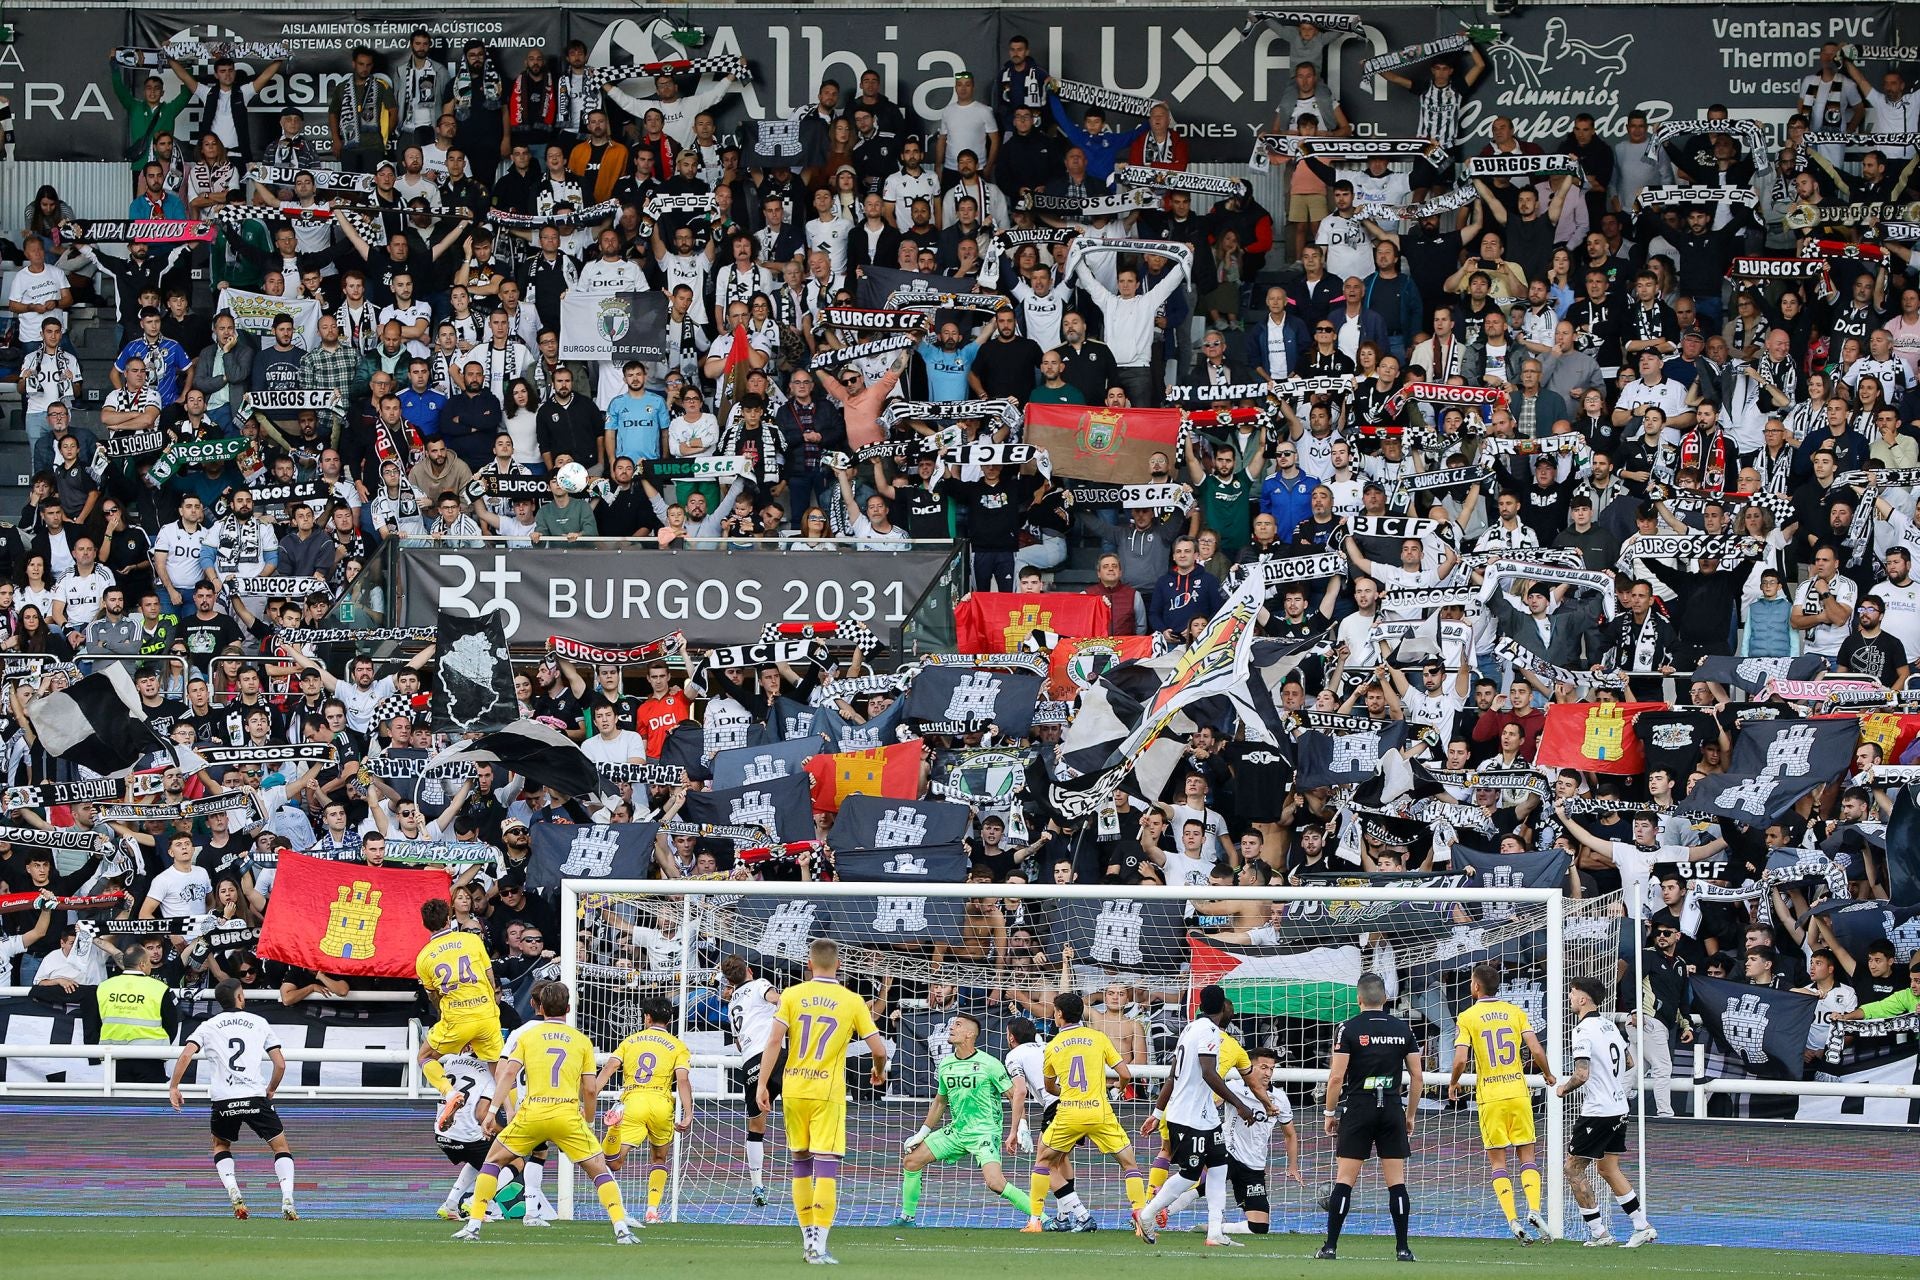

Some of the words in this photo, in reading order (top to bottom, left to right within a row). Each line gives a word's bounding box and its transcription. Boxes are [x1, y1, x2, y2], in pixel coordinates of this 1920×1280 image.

[281, 23, 371, 35] AISLAMIENTOS
[1712, 18, 1822, 39] Ventanas
[1829, 17, 1875, 38] PVC
[282, 37, 341, 50] SISTEMAS
[344, 37, 373, 50] CON
[483, 37, 546, 49] LAMINADO
[1861, 44, 1919, 59] BURGOS
[682, 25, 978, 121] Albia
[1729, 79, 1757, 94] Uw
[1059, 83, 1095, 102] BURGOS
[1096, 90, 1119, 107] CLUB
[1664, 119, 1731, 133] BURGOS
[1311, 142, 1391, 153] BURGOS
[1395, 142, 1425, 154] CF
[1474, 157, 1541, 174] BURGOS
[1544, 157, 1572, 172] C.F.
[1035, 193, 1099, 210] BURGOS
[1105, 194, 1132, 208] C.F.
[1641, 190, 1726, 202] BURGOS
[1729, 191, 1756, 204] CF
[1817, 206, 1878, 222] BURGOS
[86, 222, 124, 239] AUPA
[127, 220, 185, 238] BURGOS
[673, 268, 698, 278] DIGI
[1738, 259, 1802, 276] BURGOS
[591, 280, 624, 288] DIGI
[1028, 303, 1056, 312] DIGI
[243, 318, 273, 328] CLU
[830, 309, 893, 329] BURGOS
[898, 311, 918, 329] CF
[1834, 318, 1866, 336] DIGI
[563, 345, 597, 353] BURGOS
[596, 345, 618, 354] CLUB
[618, 346, 630, 354] DE
[631, 346, 662, 355] FUTBOL
[836, 334, 913, 364] CAMPEADOR
[934, 363, 966, 372] DIGI
[252, 389, 304, 409] BURGOS
[1170, 386, 1192, 402] OY
[623, 419, 654, 428] DIGI
[120, 430, 163, 455] BURGOS
[654, 463, 710, 476] BURGOS
[714, 460, 735, 472] C.F.
[498, 480, 551, 494] BURGO
[1414, 473, 1450, 489] BURGOS
[294, 483, 317, 498] C.F.
[1073, 487, 1138, 504] BURGOS
[1142, 484, 1169, 500] C.F.
[911, 504, 942, 515] DIGI
[1633, 535, 1703, 555] BURGOS
[1263, 557, 1316, 580] URGOS
[243, 577, 296, 593] BURGOS
[69, 595, 97, 606] DIGI
[549, 577, 762, 620] BURGOS
[783, 580, 907, 621] 2031
[1891, 601, 1916, 609] REALE
[555, 638, 651, 663] BURGOSCF
[650, 713, 677, 731] DIGI
[719, 715, 750, 726] DIGI
[1308, 713, 1384, 731] BURGOS
[1417, 710, 1444, 720] DIGI
[213, 749, 291, 763] BURGOS
[300, 747, 325, 759] CF
[974, 755, 1004, 764] CLUB
[71, 778, 119, 801] BURGOS
[1678, 862, 1728, 878] BCF
[211, 926, 261, 946] BURGO
[434, 955, 483, 994] 24
[109, 993, 145, 1004] SICOR
[448, 995, 489, 1010] MERITKING
[812, 997, 839, 1010] BIUK
[217, 1018, 254, 1030] LIZANCOS
[730, 1003, 743, 1034] 6
[1480, 1013, 1509, 1023] TOMEO
[638, 1034, 676, 1052] MESEGUER
[799, 1015, 838, 1061] 17
[1064, 1039, 1094, 1049] TORRES
[228, 1037, 246, 1072] 2
[1480, 1028, 1516, 1068] 15
[449, 1058, 488, 1075] MORANTE
[548, 1047, 567, 1088] 7
[634, 1052, 658, 1085] 8
[1610, 1043, 1620, 1078] 9
[947, 1076, 977, 1089] DIGI
[1068, 1056, 1088, 1093] 4
[1483, 1073, 1522, 1086] MERITKING
[1191, 1137, 1205, 1153] 10
